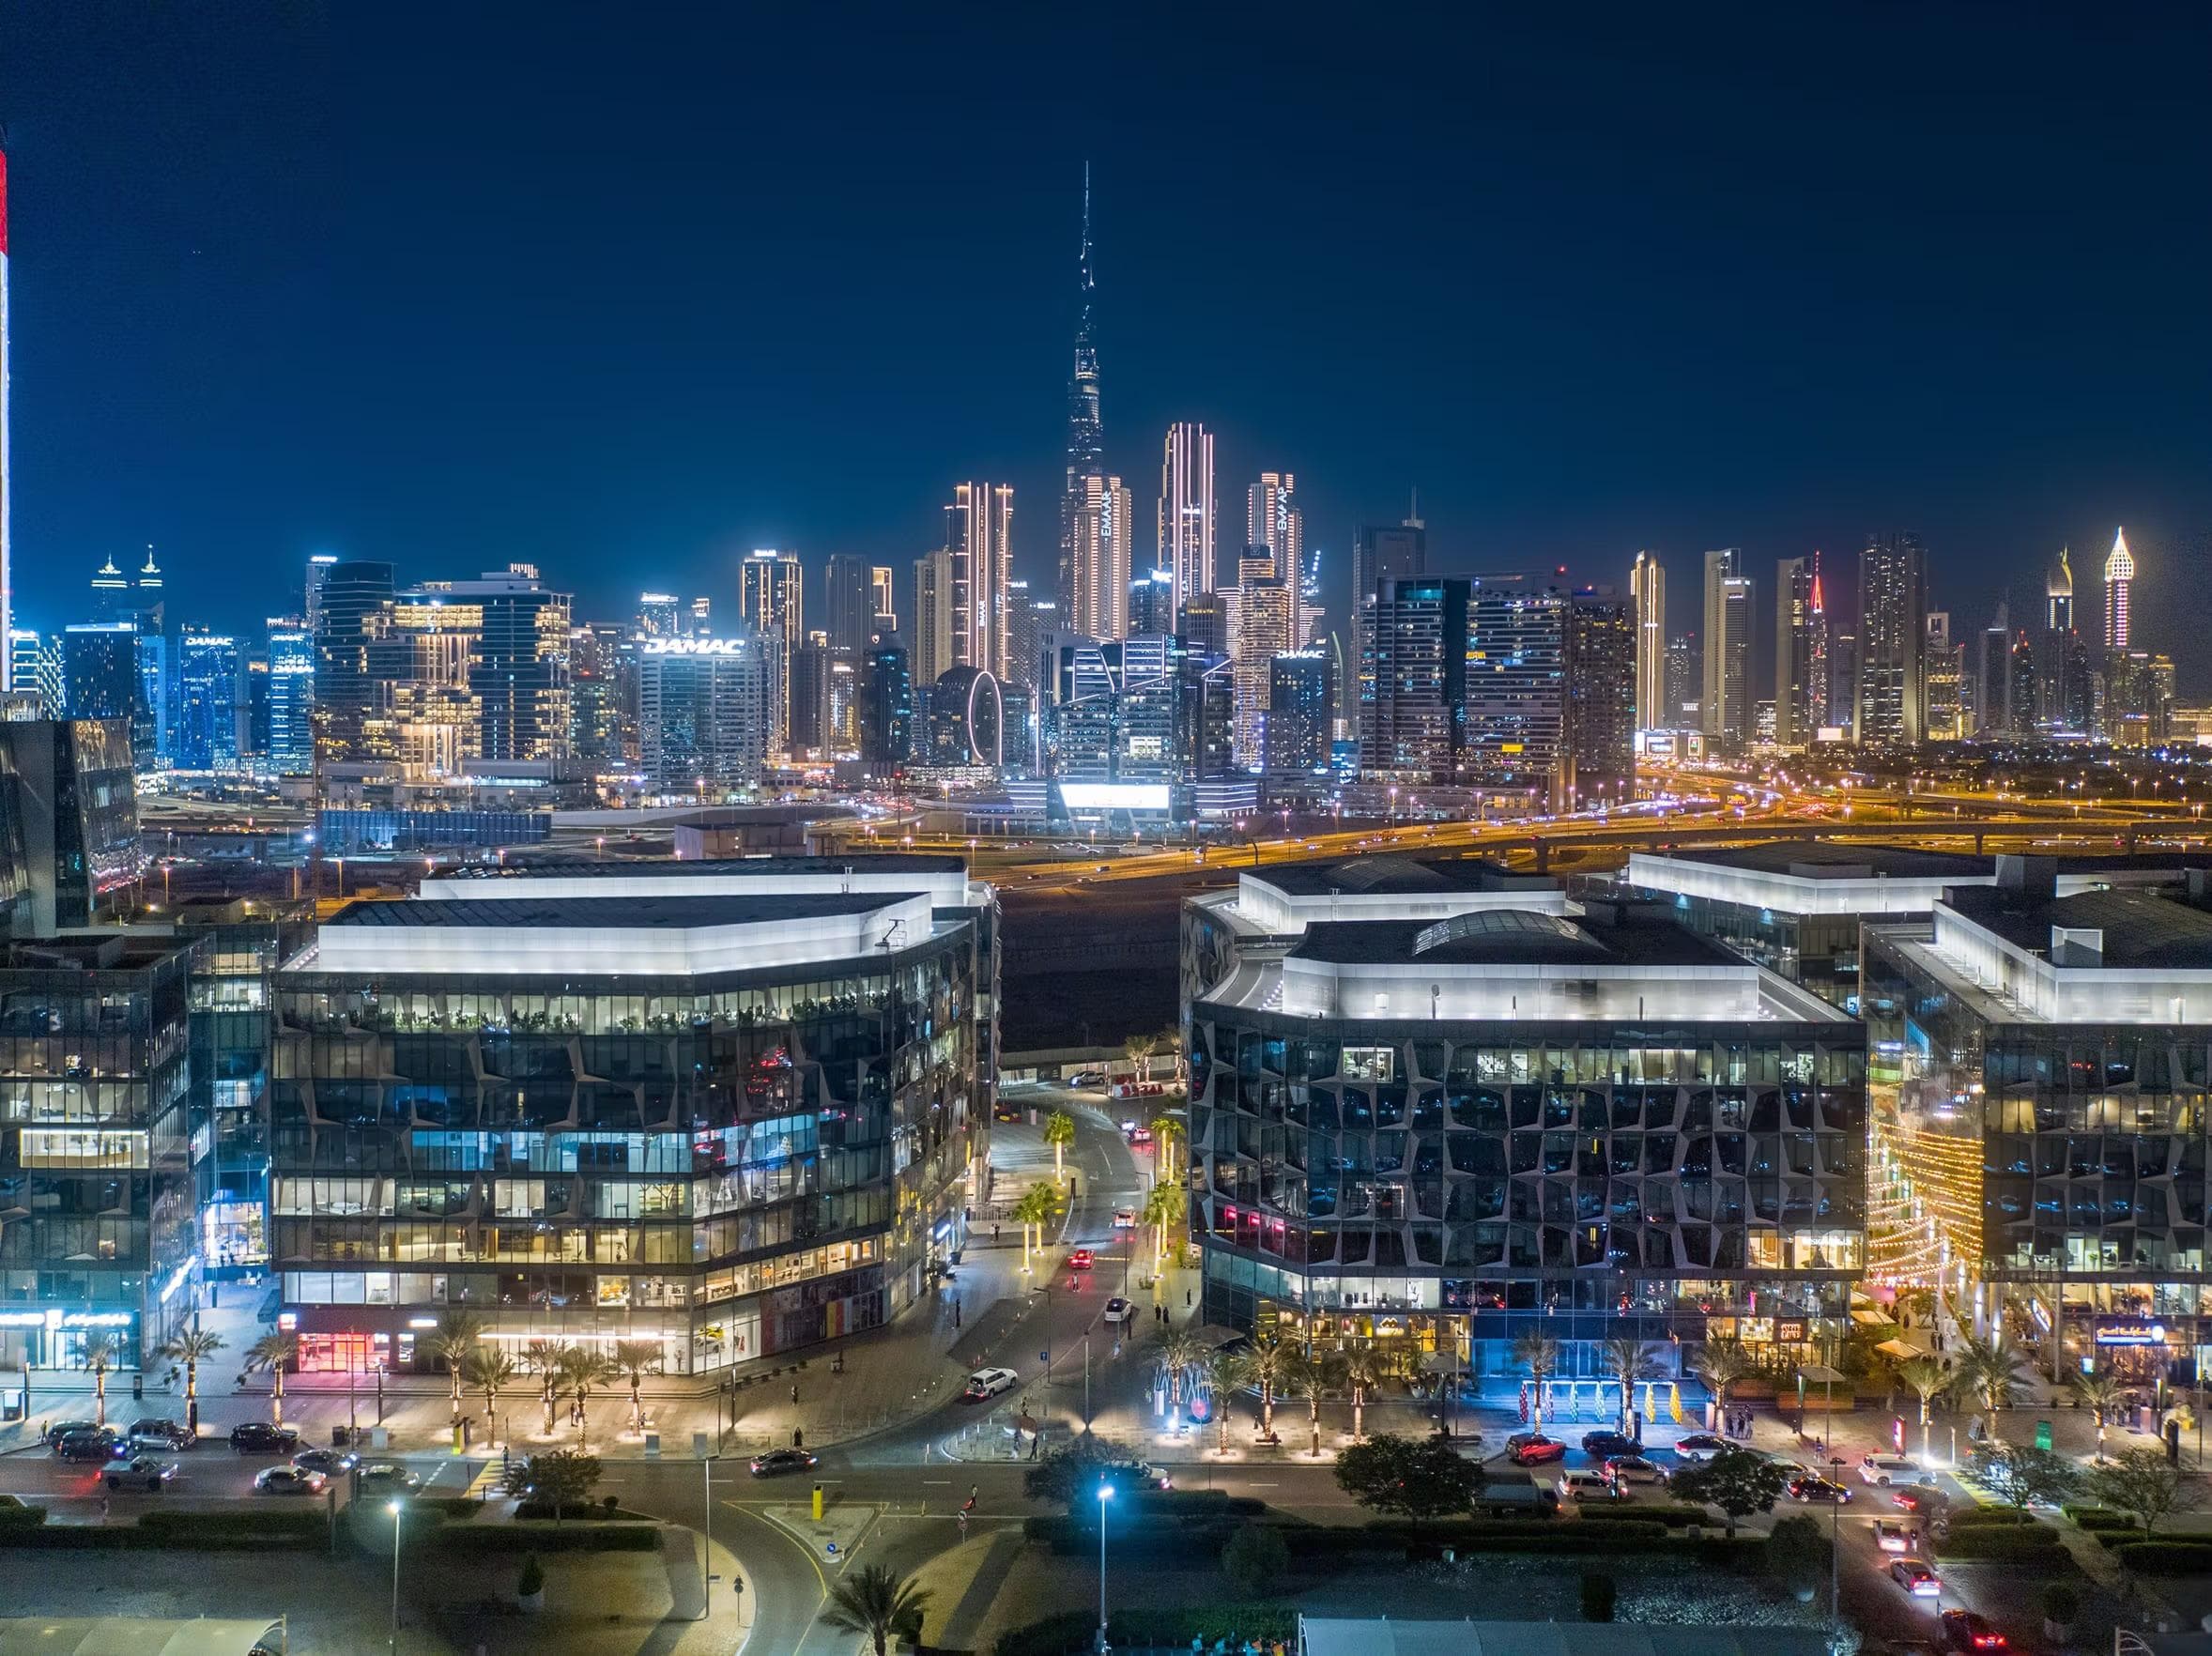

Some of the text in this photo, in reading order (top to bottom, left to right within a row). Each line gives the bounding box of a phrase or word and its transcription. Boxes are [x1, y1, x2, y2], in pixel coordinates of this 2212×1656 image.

[1101, 491, 1112, 536] EMAAR
[186, 637, 234, 646] DAMAC
[642, 638, 745, 654] DAMAC
[1276, 650, 1326, 659] DAMAC
